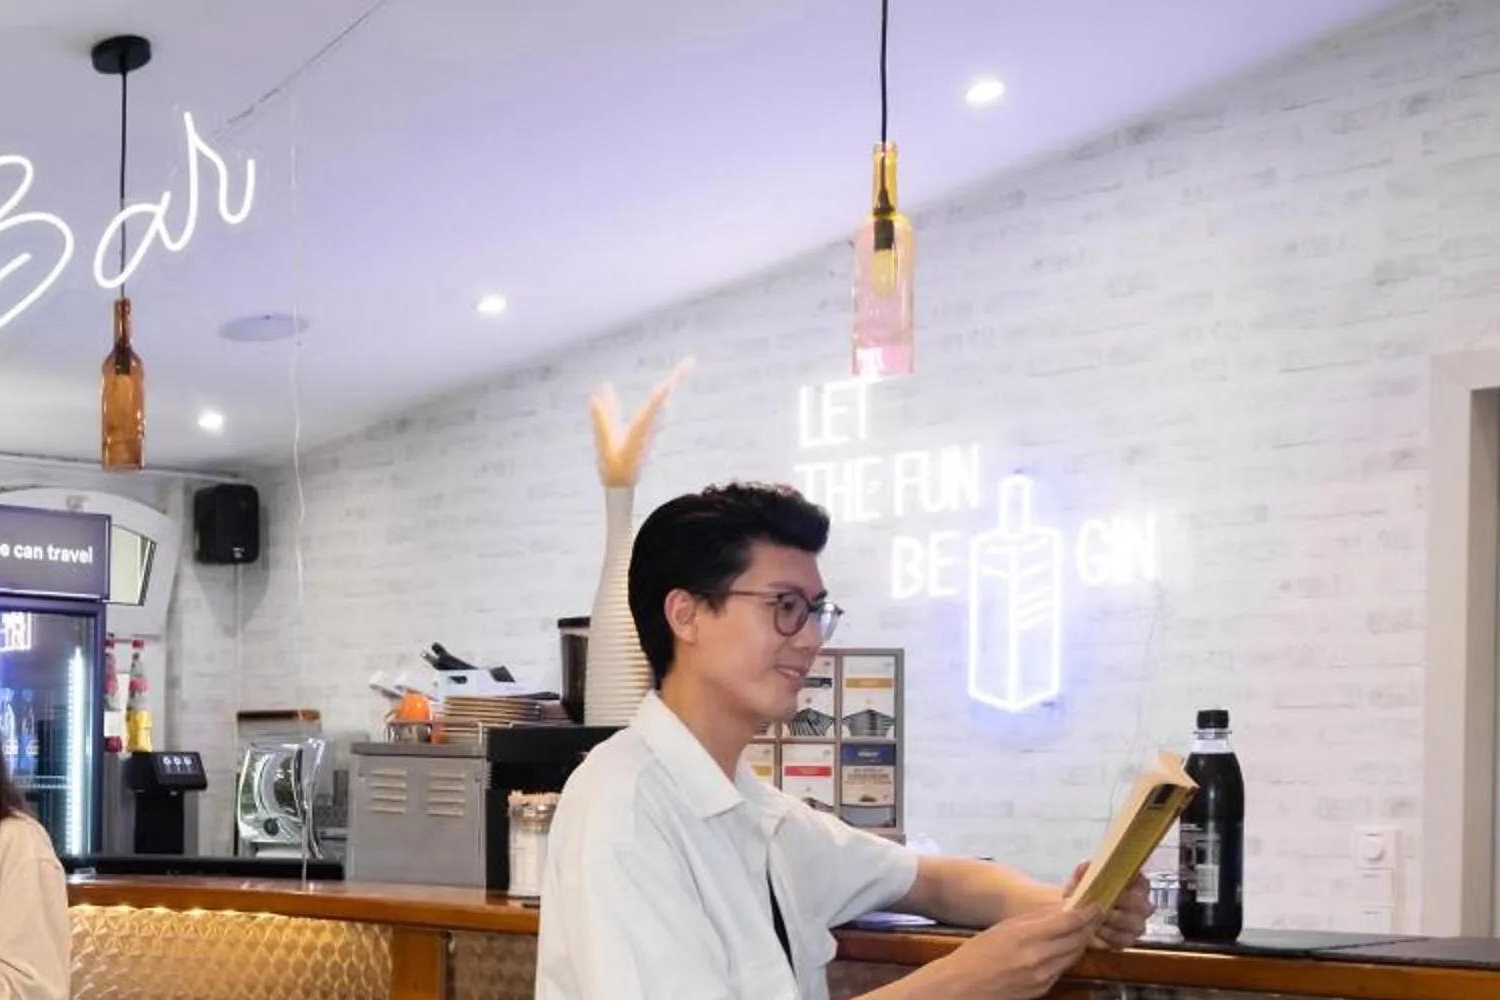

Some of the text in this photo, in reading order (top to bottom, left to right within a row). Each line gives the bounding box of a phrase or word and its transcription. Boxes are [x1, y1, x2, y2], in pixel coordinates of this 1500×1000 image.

[798, 378, 885, 448] LET
[794, 444, 981, 524] THE FUN
[13, 543, 43, 561] can
[47, 543, 93, 564] travel
[891, 511, 1159, 600] BE GIN
